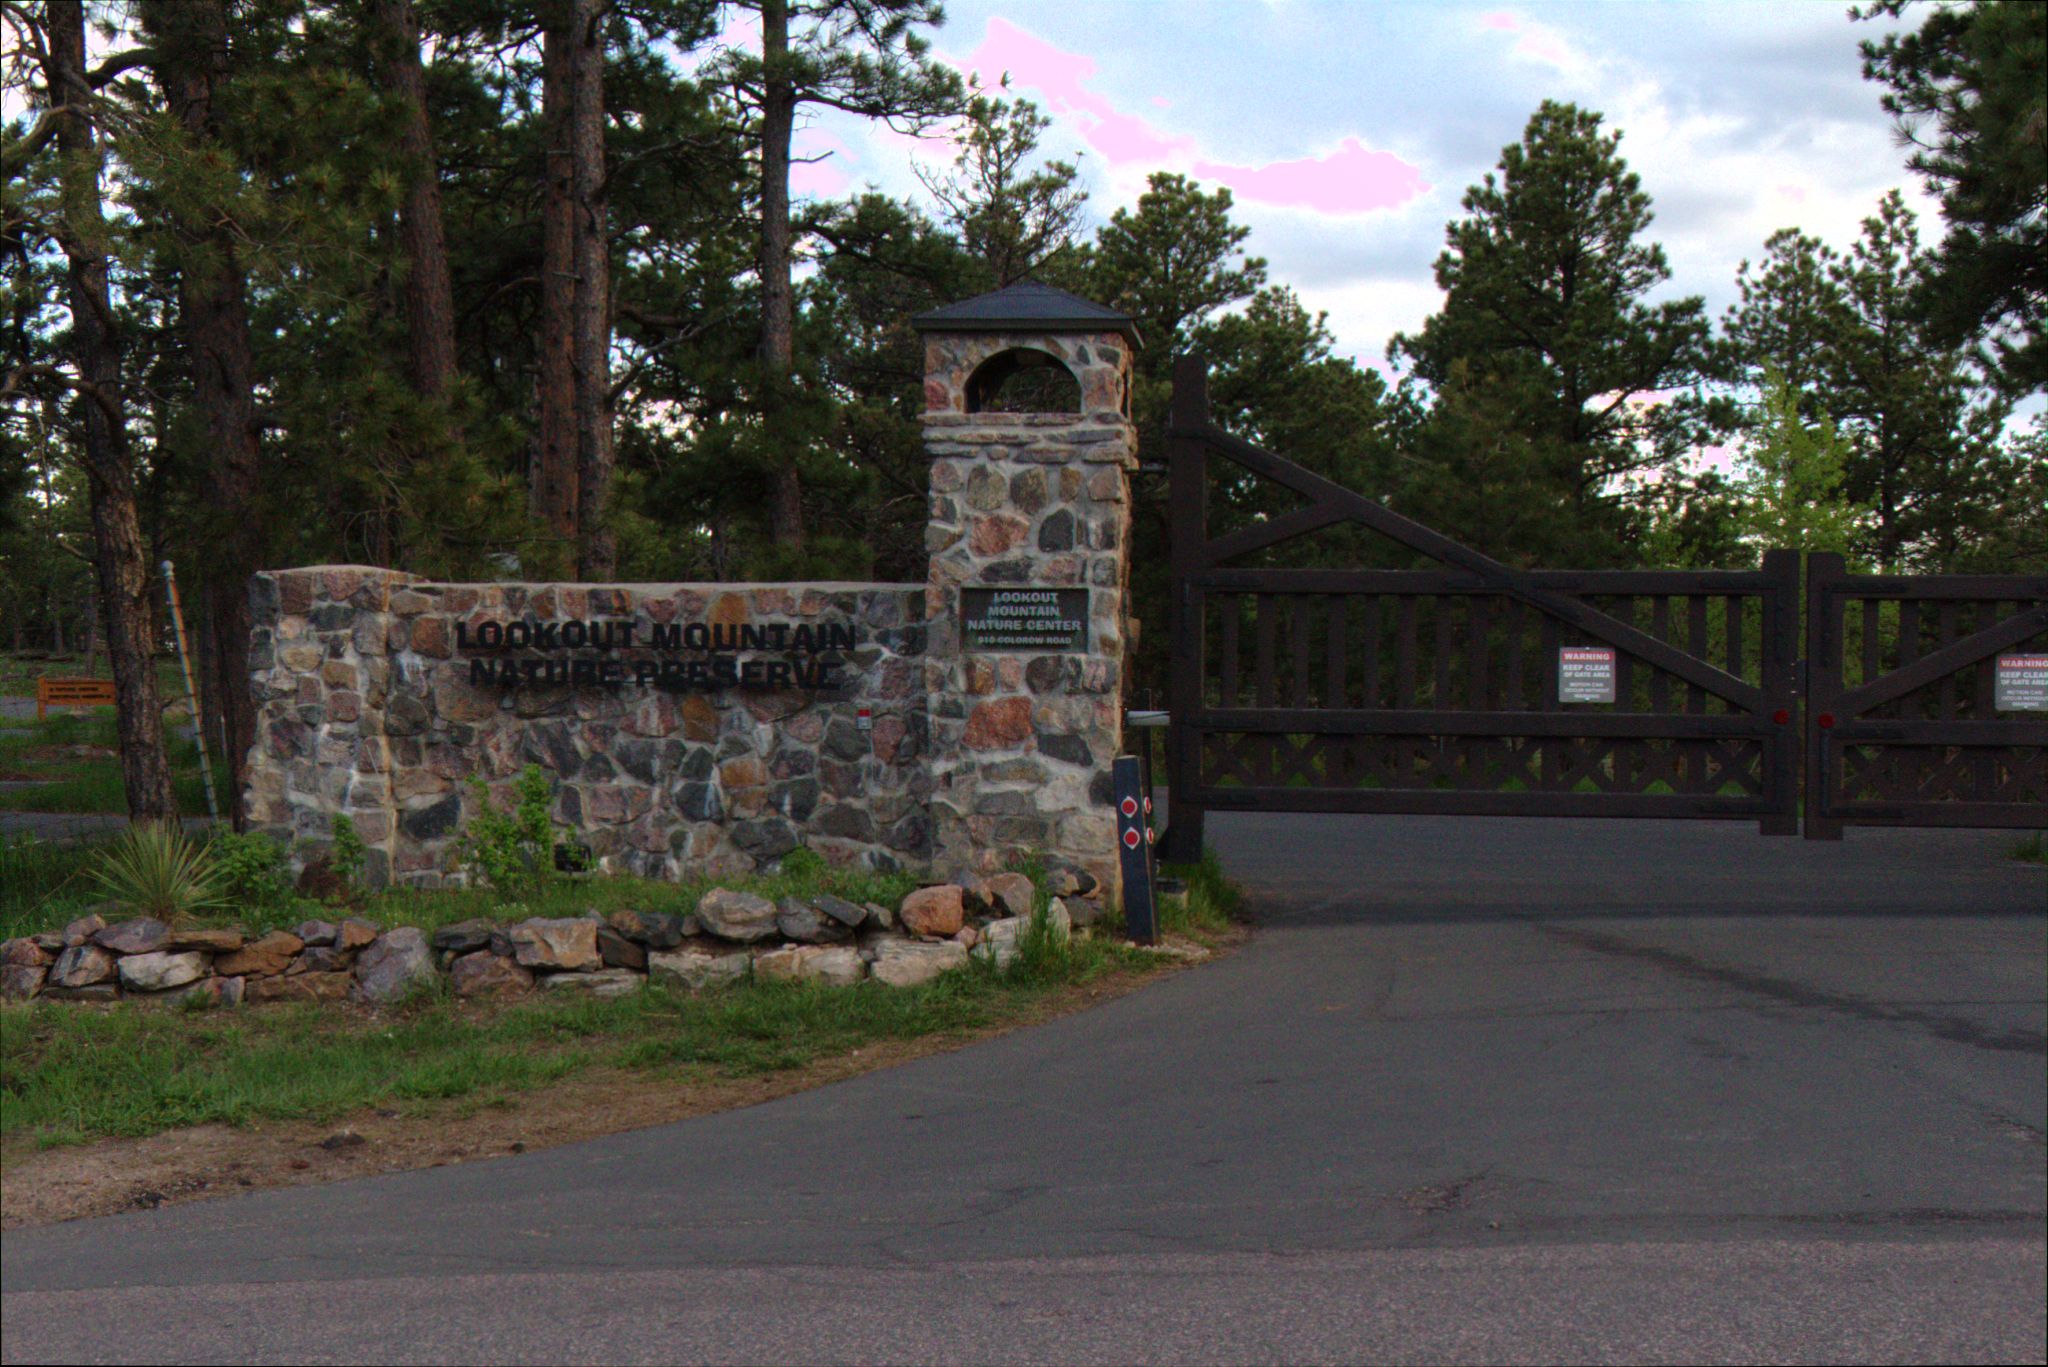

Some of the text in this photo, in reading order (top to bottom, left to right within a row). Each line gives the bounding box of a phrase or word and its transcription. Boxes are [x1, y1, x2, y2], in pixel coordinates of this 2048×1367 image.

[993, 592, 1059, 604] LOOKOUT
[987, 605, 1061, 617] MOUNTAIN
[967, 619, 1081, 631] NATURE CENTER
[456, 621, 855, 651] LOOKOUT MOUNTAIN
[1046, 636, 1072, 645] ROAD
[1563, 653, 1610, 661] WARNING
[2000, 660, 2048, 668] WARNING
[470, 659, 841, 691] NATURE PRESERVE
[1999, 671, 2022, 679] KEEP
